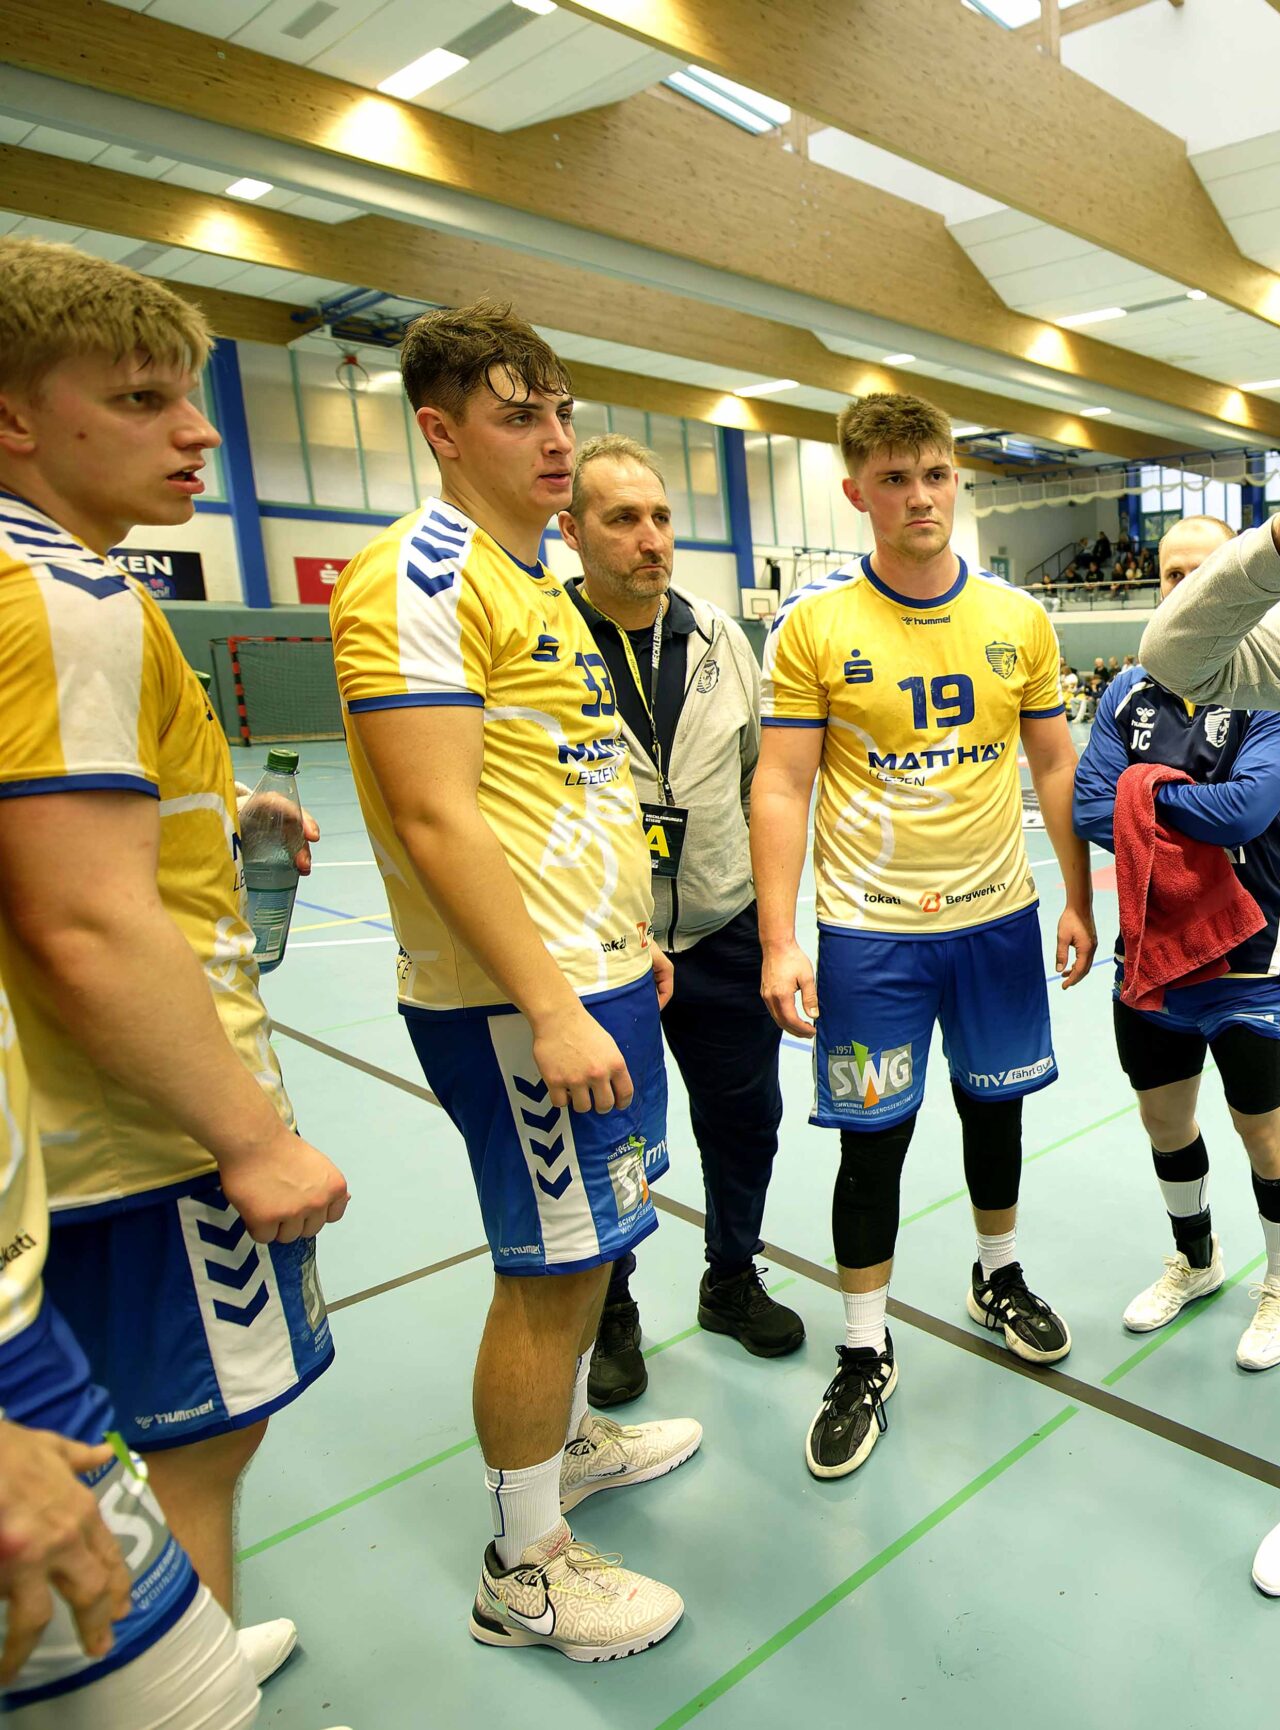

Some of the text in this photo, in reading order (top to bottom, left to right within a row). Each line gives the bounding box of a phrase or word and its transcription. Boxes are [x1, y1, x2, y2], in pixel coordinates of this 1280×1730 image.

[914, 615, 951, 625] hummel
[574, 652, 616, 717] 33
[897, 674, 975, 729] 19
[1130, 729, 1152, 751] JC
[645, 825, 670, 858] A
[945, 883, 1006, 905] Bergwerk IT
[832, 1050, 910, 1097] SWG
[968, 1071, 1006, 1088] mv
[1013, 1069, 1036, 1080] fährt
[154, 1398, 214, 1424] hummel
